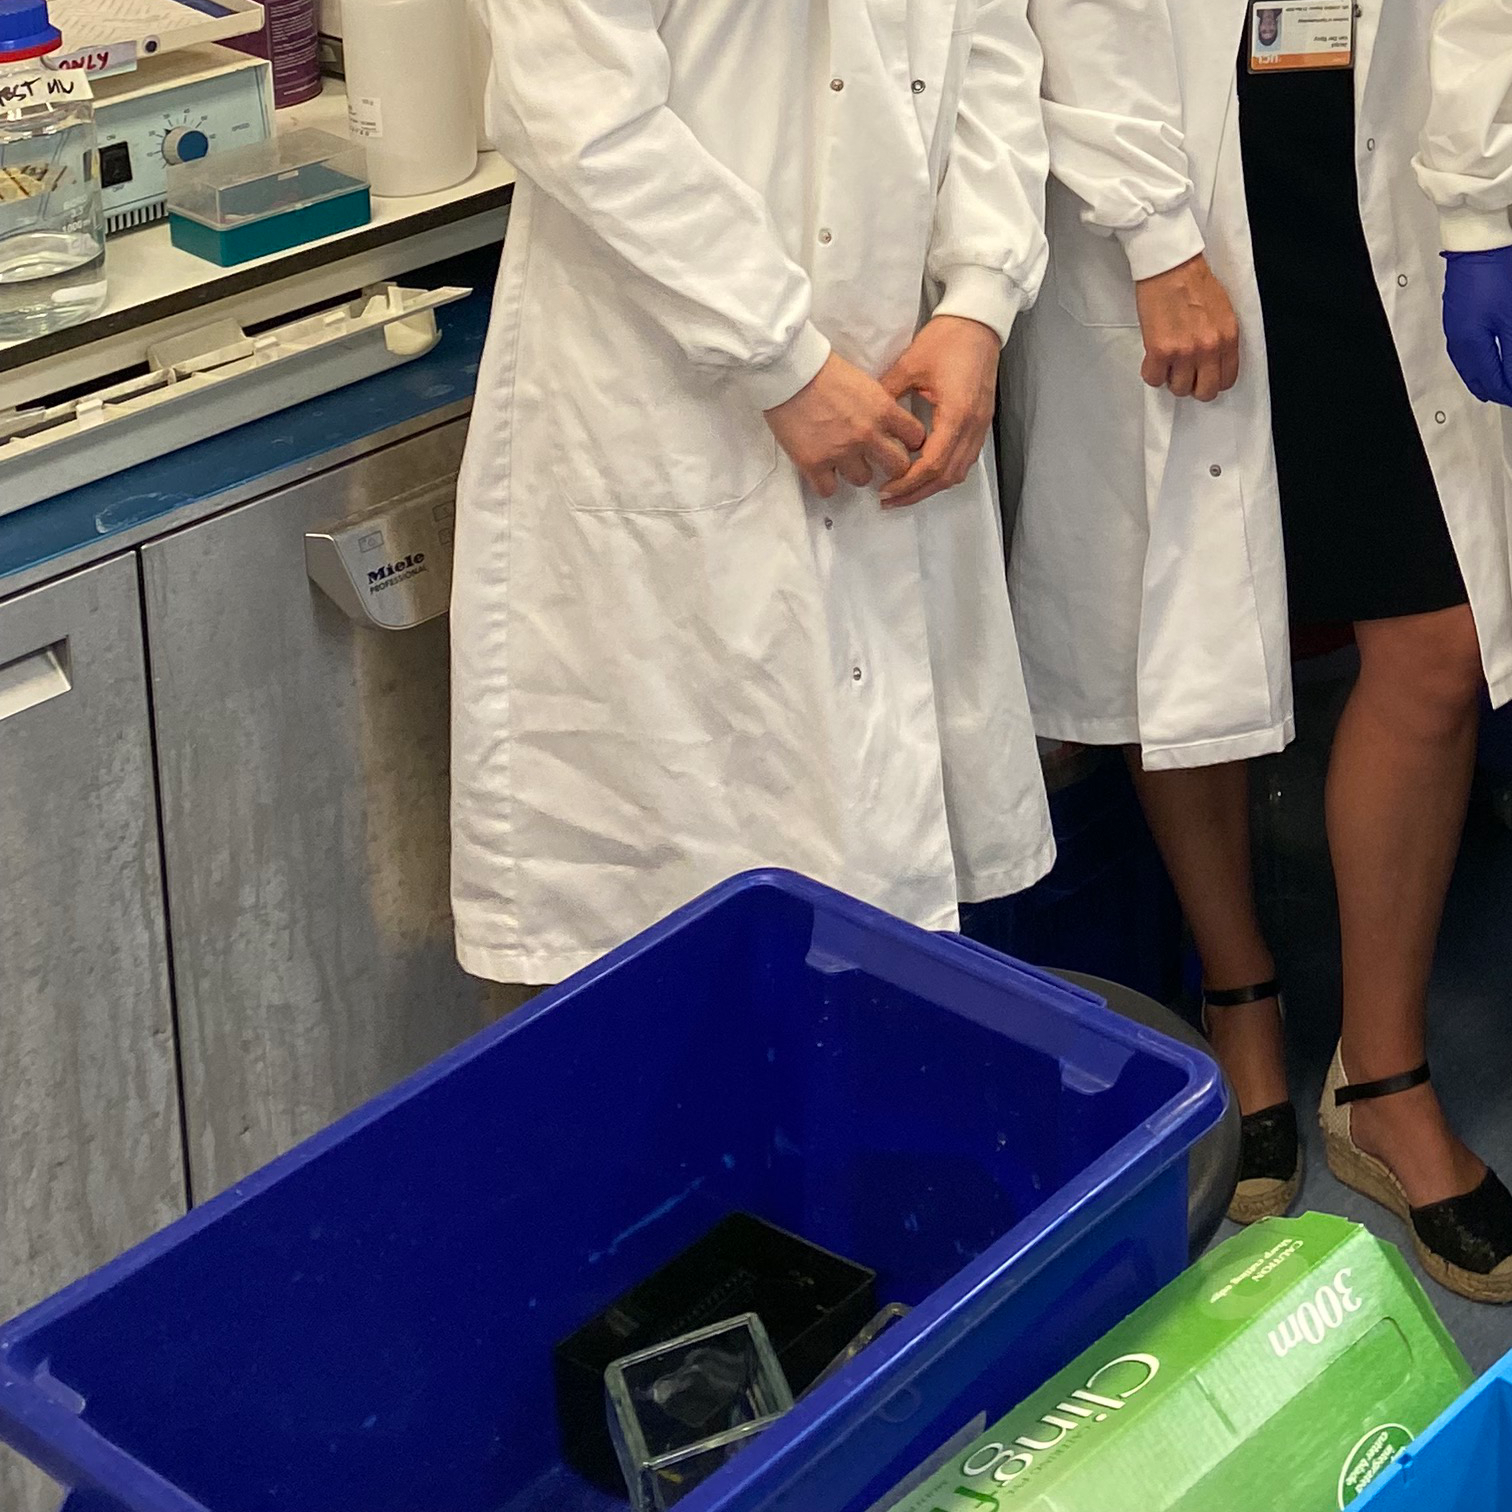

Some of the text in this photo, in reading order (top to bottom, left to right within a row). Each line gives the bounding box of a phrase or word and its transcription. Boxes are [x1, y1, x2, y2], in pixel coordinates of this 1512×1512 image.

[367, 553, 425, 585] Miele
[370, 564, 430, 596] PROFESSIONAL
[1252, 1240, 1303, 1282] CAUTION
[1267, 1268, 1363, 1358] 300m
